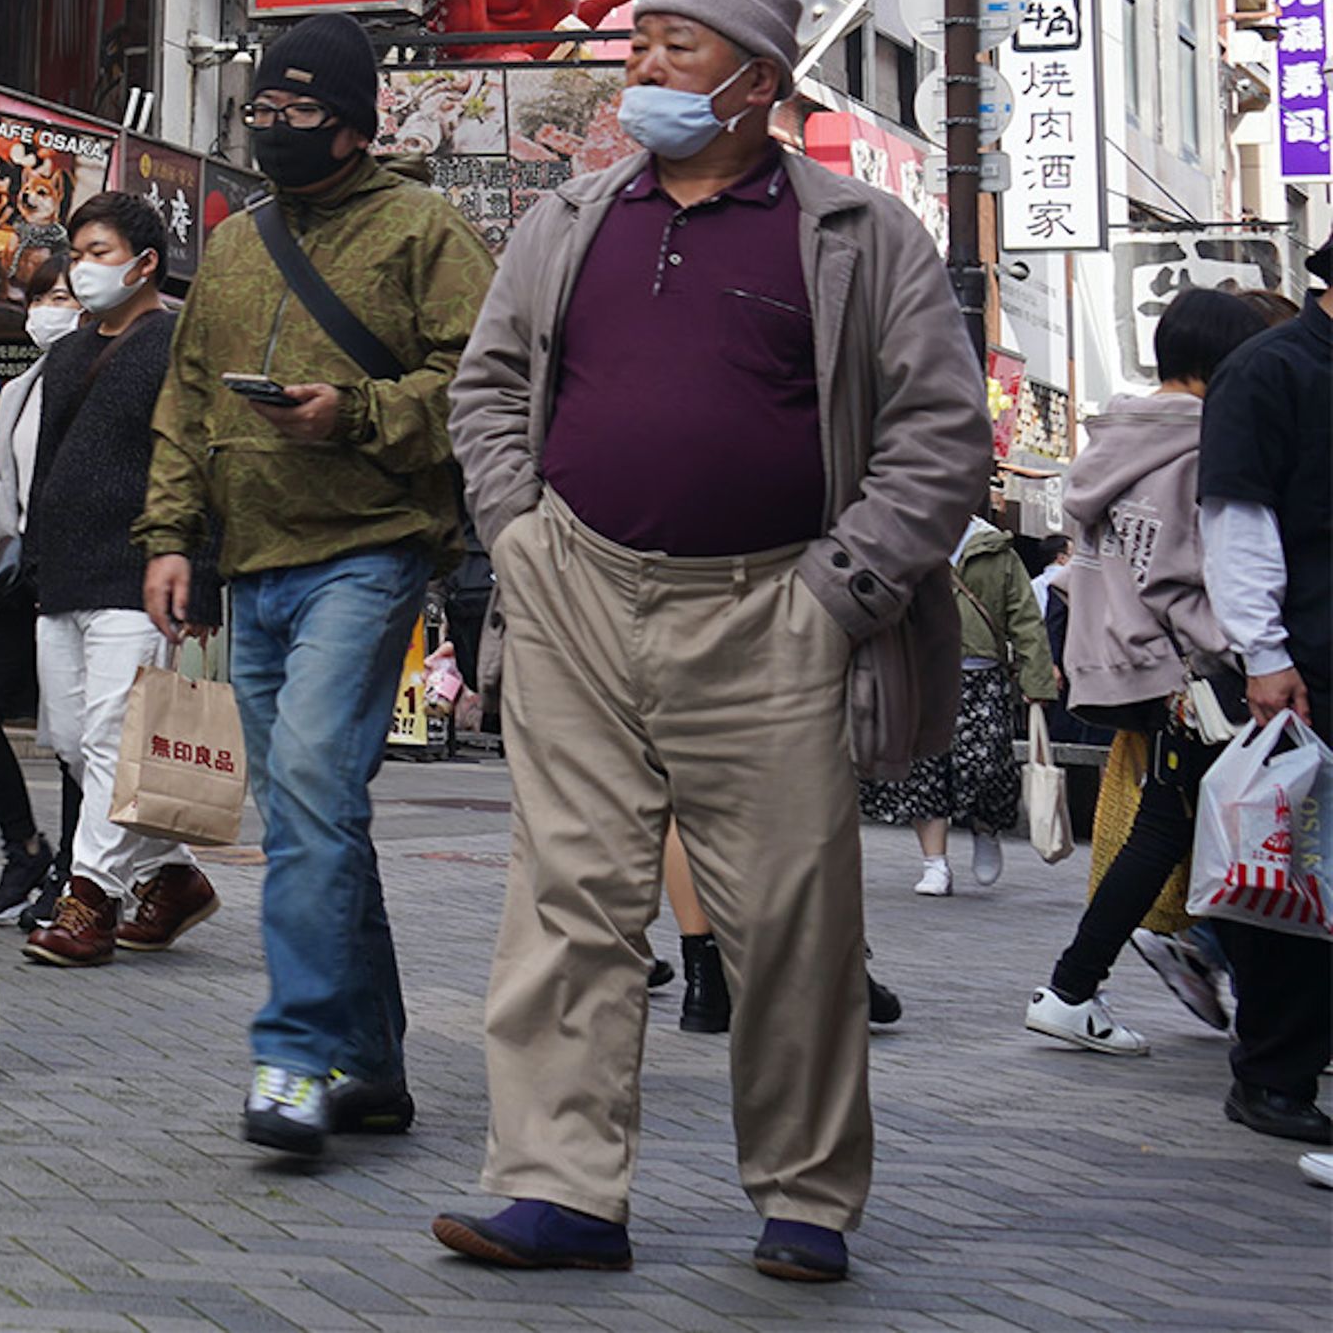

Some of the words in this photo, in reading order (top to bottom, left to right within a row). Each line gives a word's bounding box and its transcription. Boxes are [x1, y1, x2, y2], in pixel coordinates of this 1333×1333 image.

[38, 130, 107, 162] OSAKA
[151, 734, 235, 774] 無印良品
